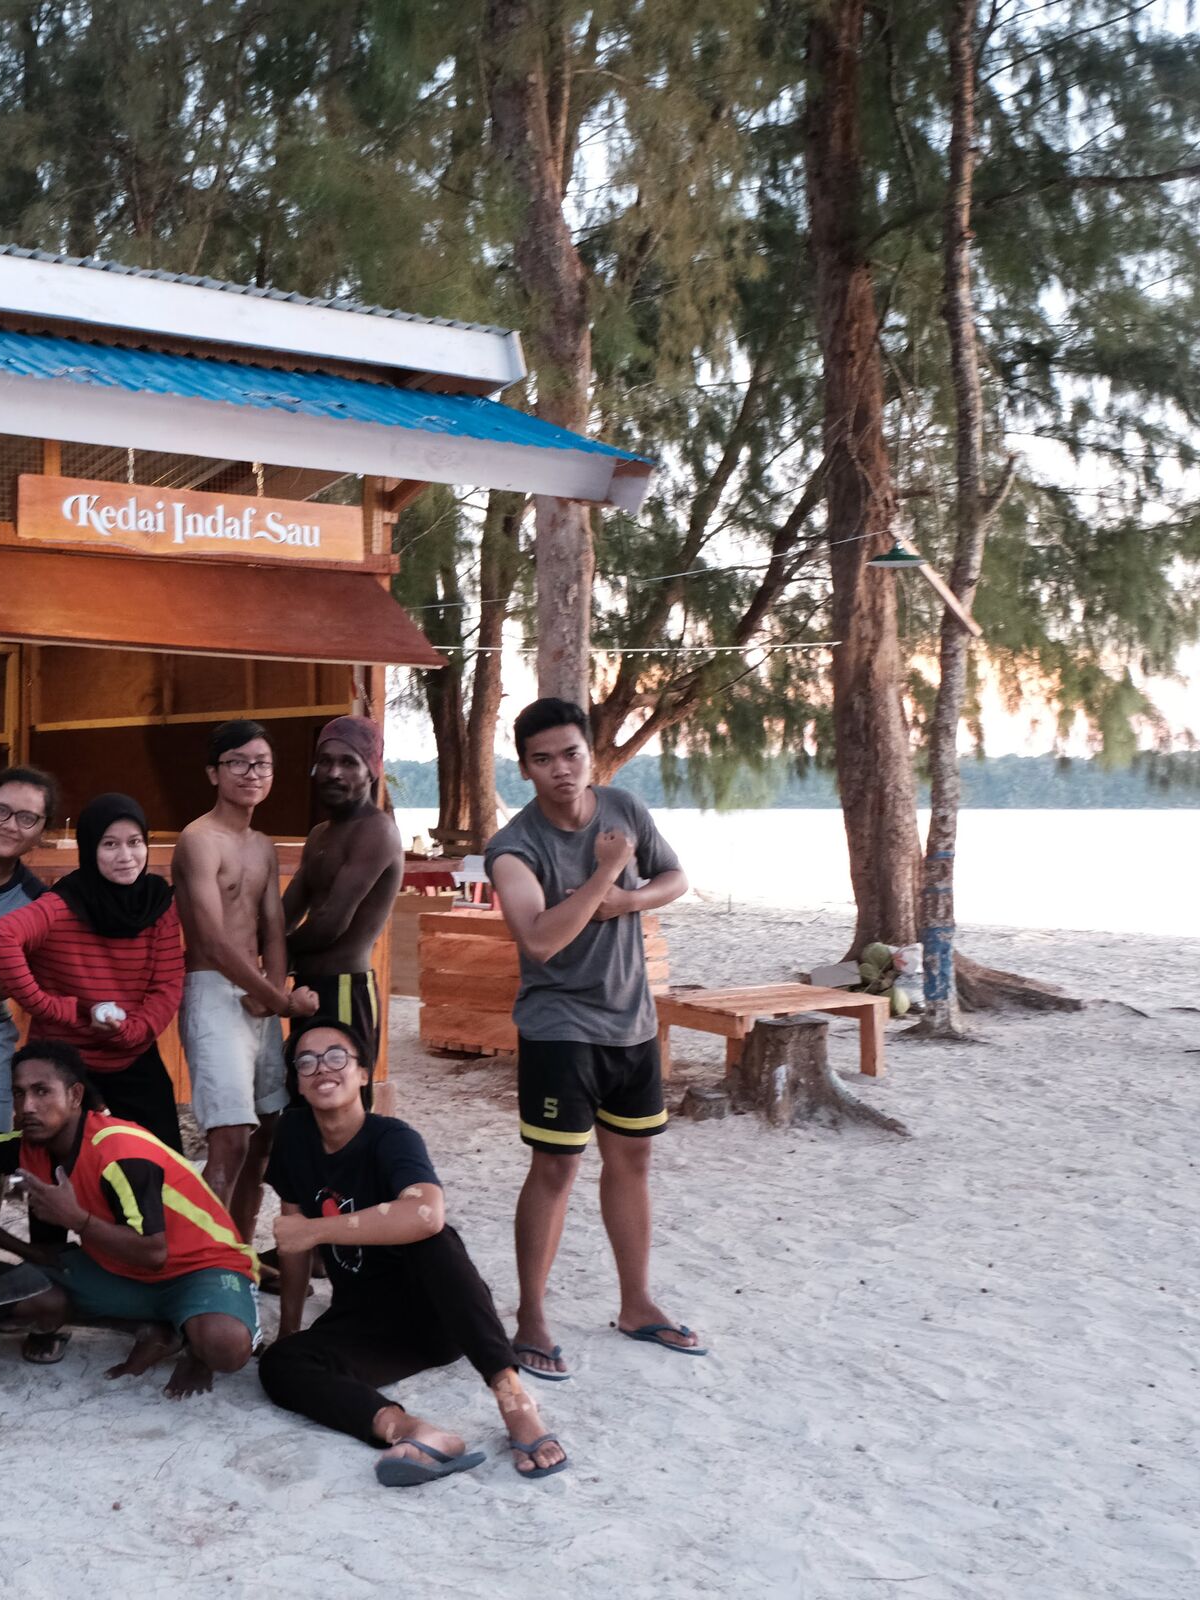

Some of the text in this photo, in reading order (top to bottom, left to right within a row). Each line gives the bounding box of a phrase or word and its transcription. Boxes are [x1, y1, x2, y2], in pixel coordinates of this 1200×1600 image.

[62, 494, 321, 548] Kedai Indaf Sau
